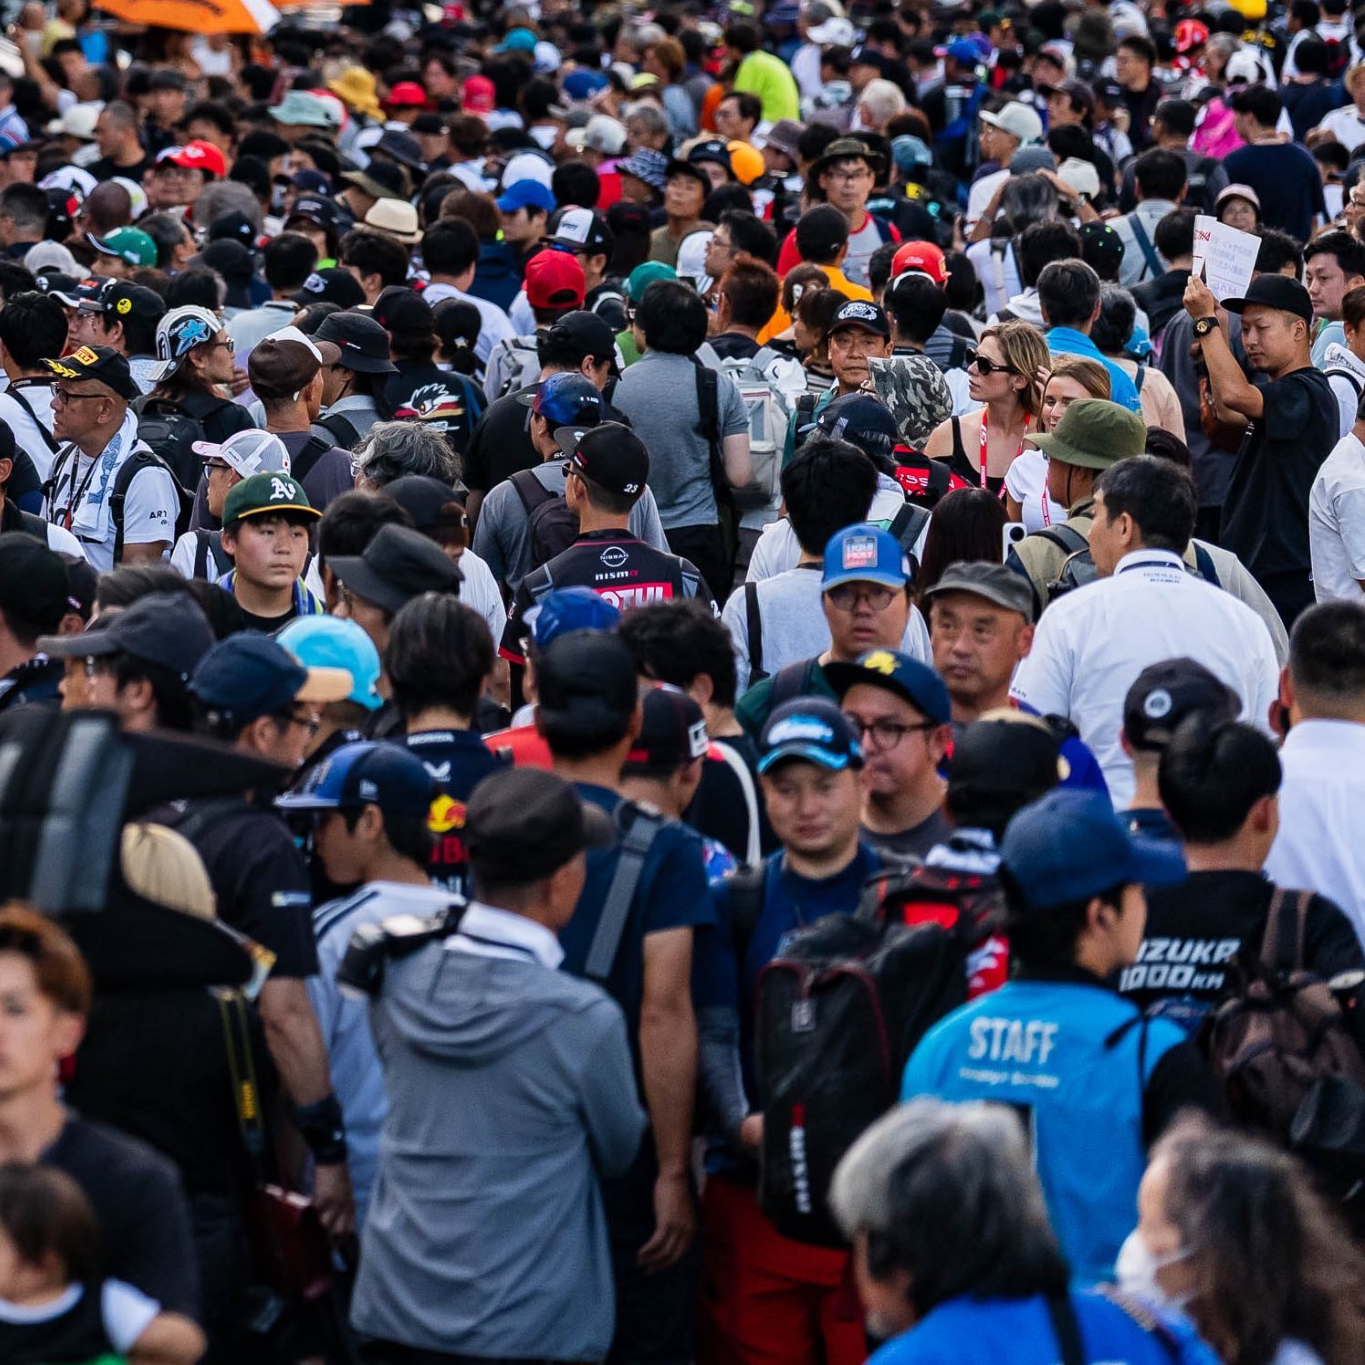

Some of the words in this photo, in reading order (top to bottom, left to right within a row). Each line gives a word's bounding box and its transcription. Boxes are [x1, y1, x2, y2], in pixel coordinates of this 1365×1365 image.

[600, 553, 629, 561] NISSAN
[600, 586, 662, 608] OTUL
[968, 1016, 1059, 1065] STAFF
